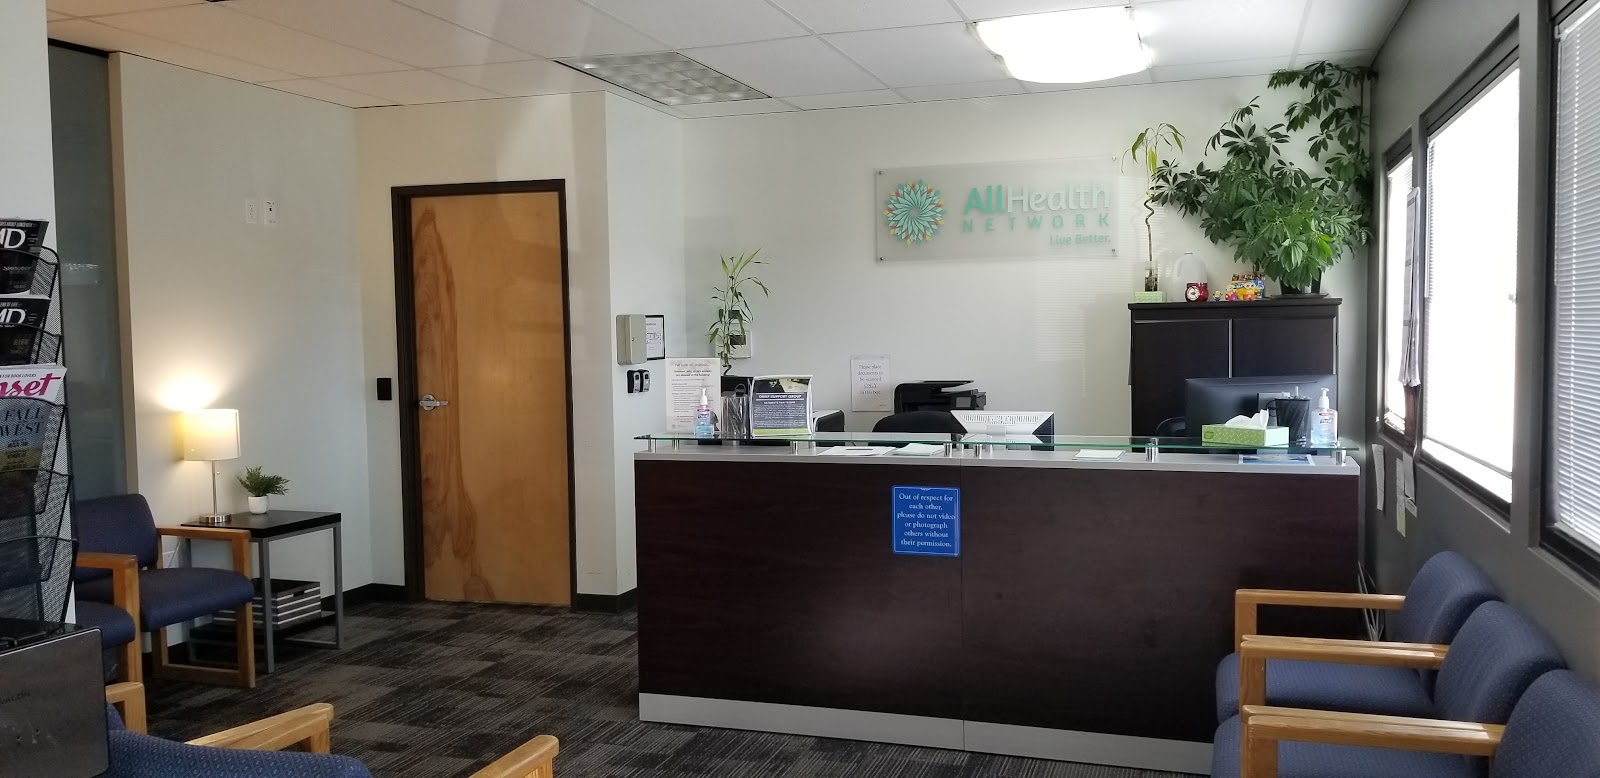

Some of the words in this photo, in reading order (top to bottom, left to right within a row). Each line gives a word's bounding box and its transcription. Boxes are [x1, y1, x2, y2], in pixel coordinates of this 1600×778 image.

[964, 184, 1111, 216] AllHealth
[962, 213, 1110, 233] NETWORK
[1049, 235, 1072, 246] Live
[1075, 234, 1111, 246] Better.
[5, 407, 43, 421] FALL
